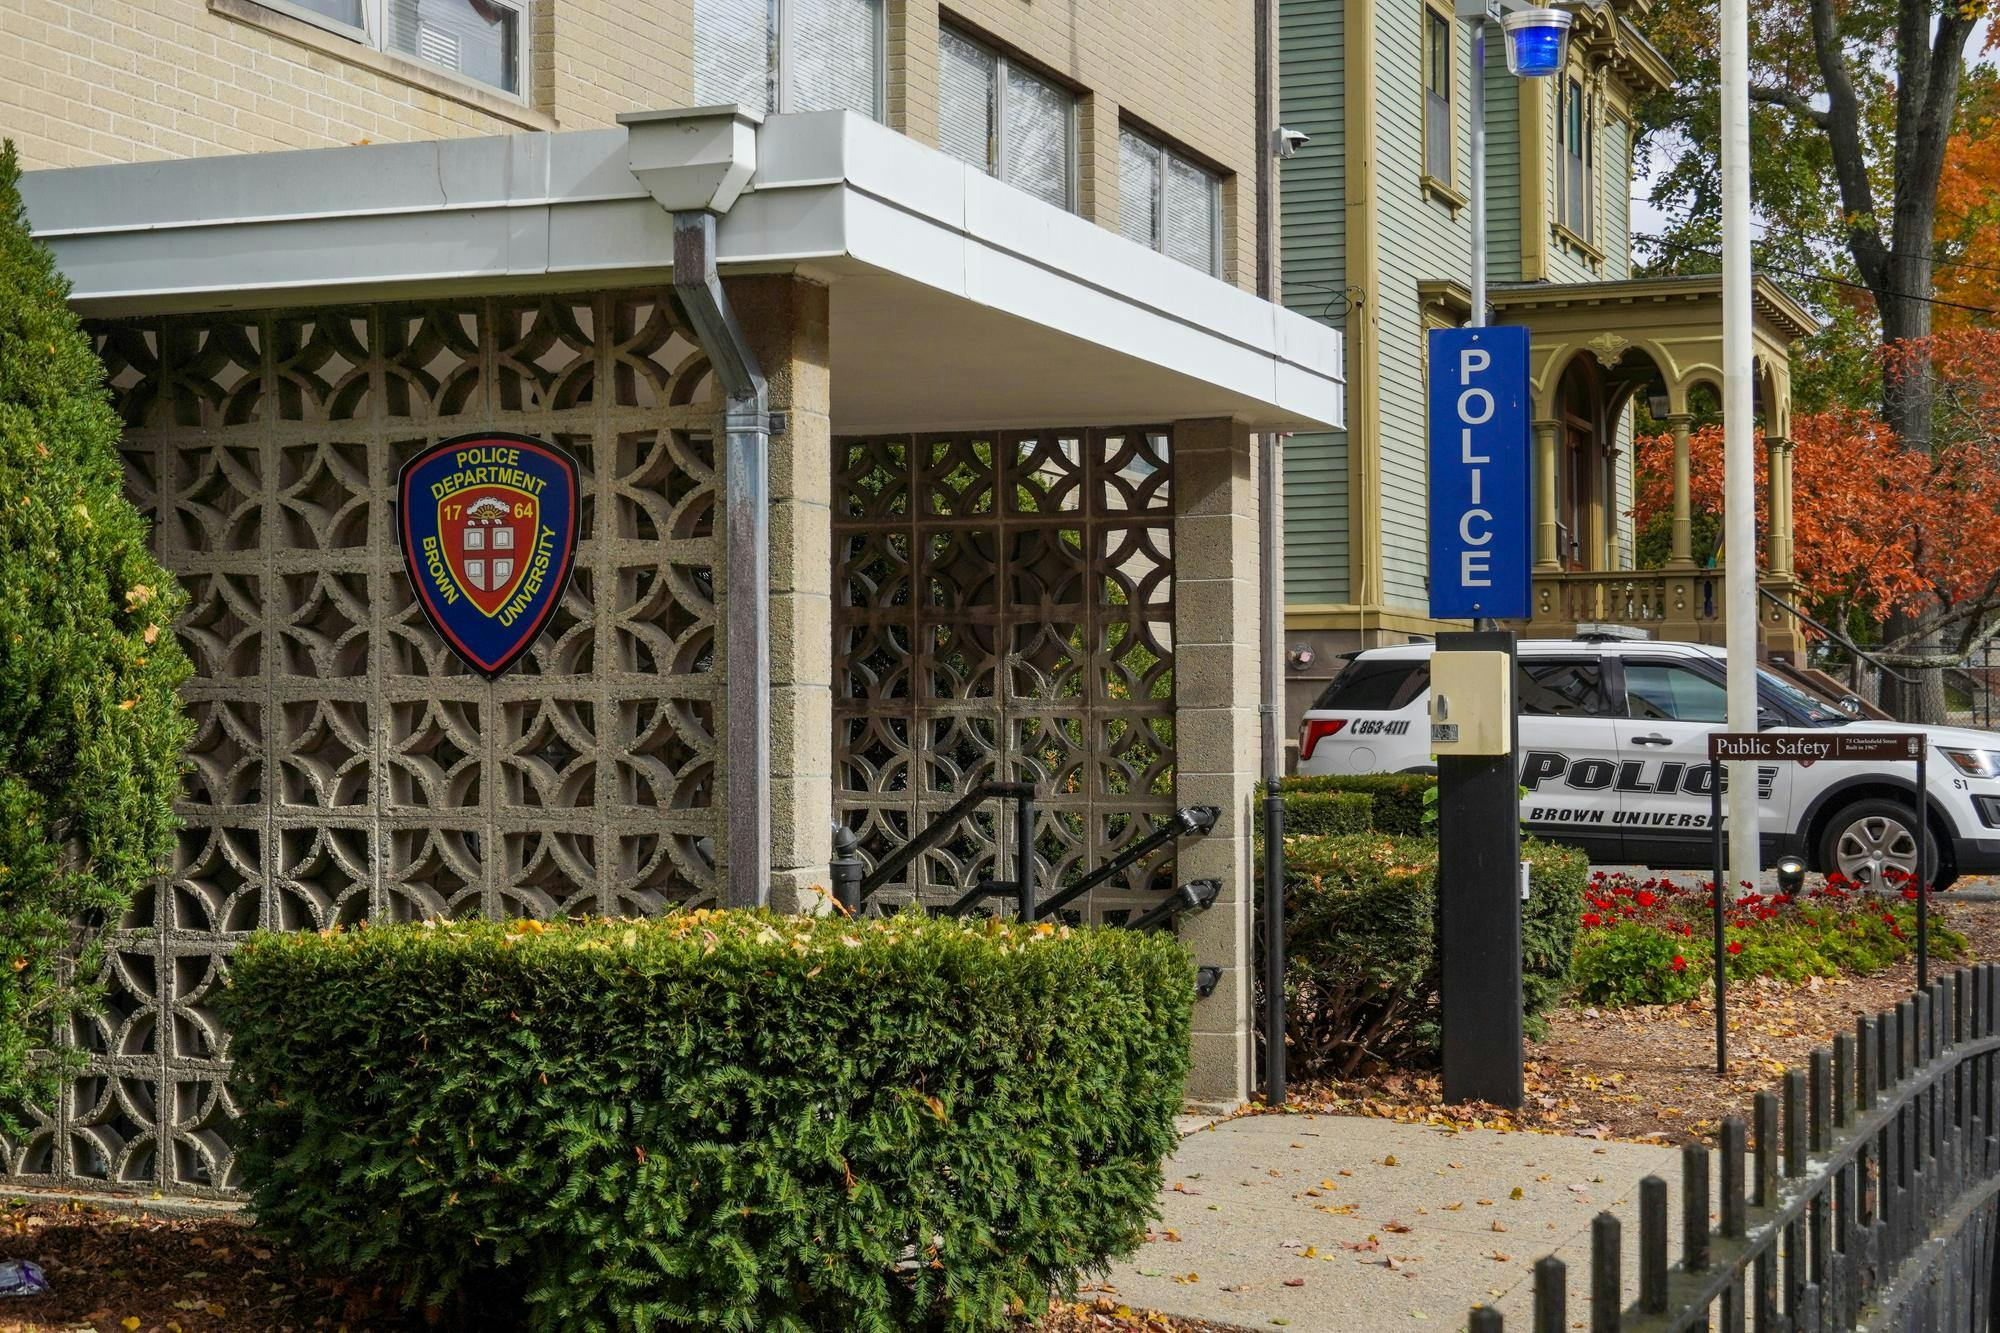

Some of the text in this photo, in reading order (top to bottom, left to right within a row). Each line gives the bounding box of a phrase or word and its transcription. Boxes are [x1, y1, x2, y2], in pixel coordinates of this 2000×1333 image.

[456, 447, 520, 468] POLICE
[1457, 349, 1495, 587] POLICE
[430, 466, 547, 500] DEPARTMENT
[444, 502, 533, 520] 17 64
[422, 535, 460, 605] BROWN
[498, 524, 556, 627] UNIVERSITY
[1716, 737, 1831, 758] Public Safety
[1953, 779, 1968, 790] S1
[1530, 808, 1604, 822] BROWN
[1612, 811, 1728, 828] UNIVERSI
